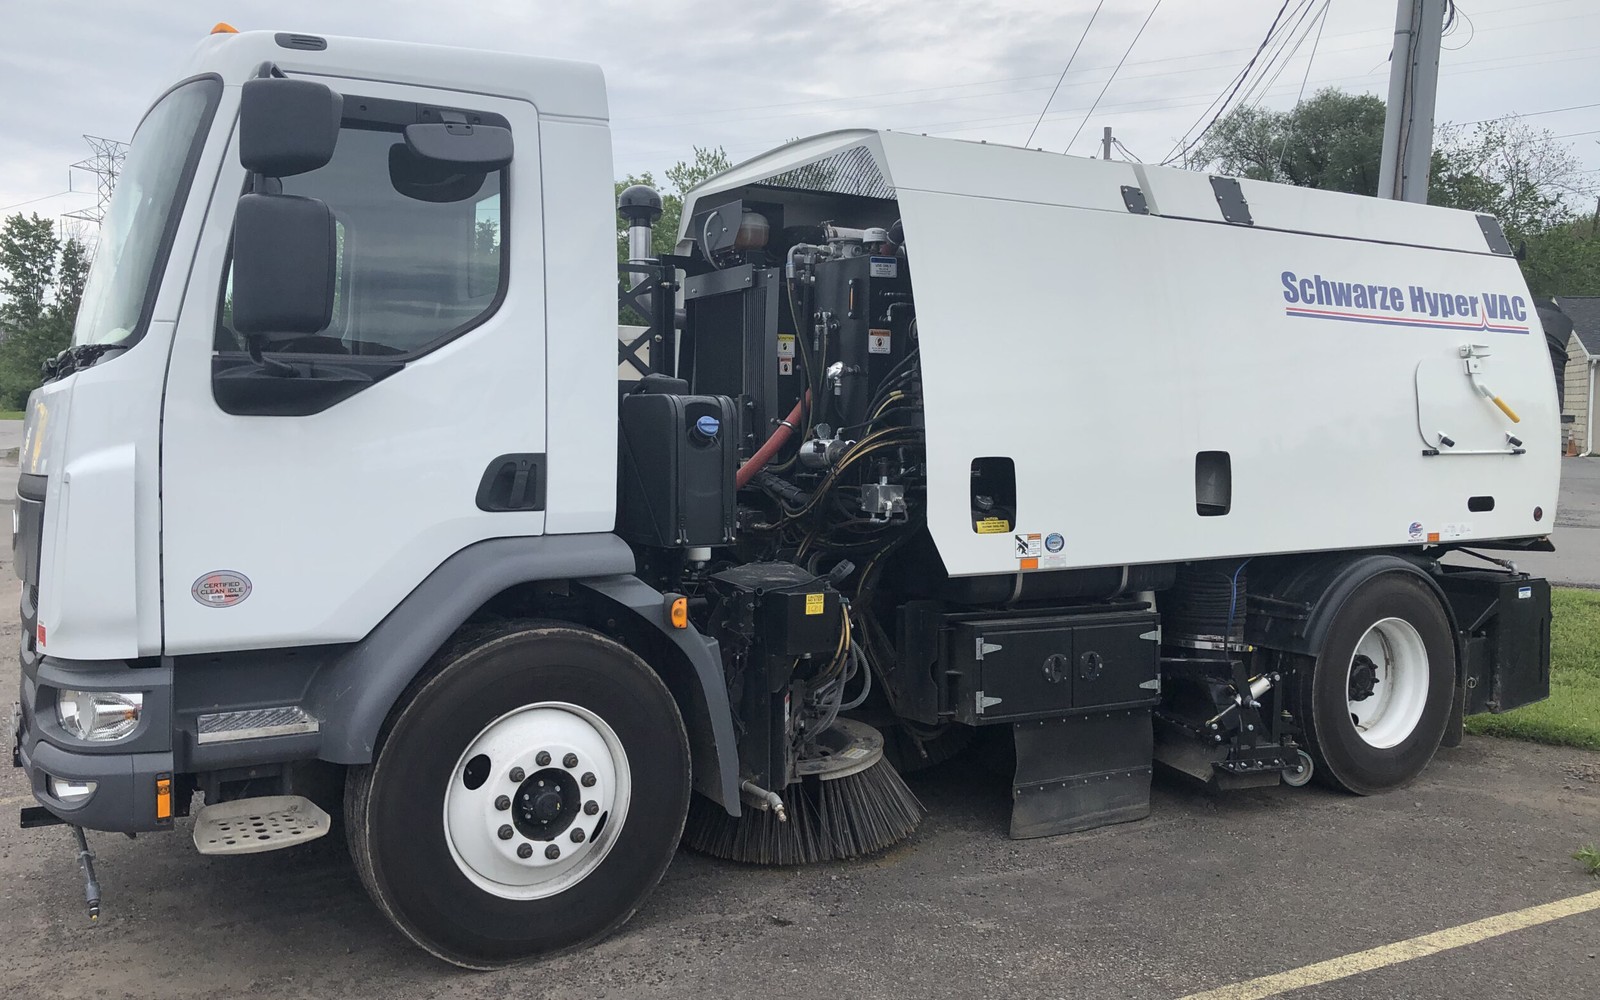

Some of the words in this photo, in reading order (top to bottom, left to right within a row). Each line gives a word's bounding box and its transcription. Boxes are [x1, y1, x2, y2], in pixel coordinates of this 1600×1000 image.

[1281, 271, 1404, 312] Schwarze
[1408, 285, 1479, 318] Hyper
[1481, 292, 1527, 322] VAC
